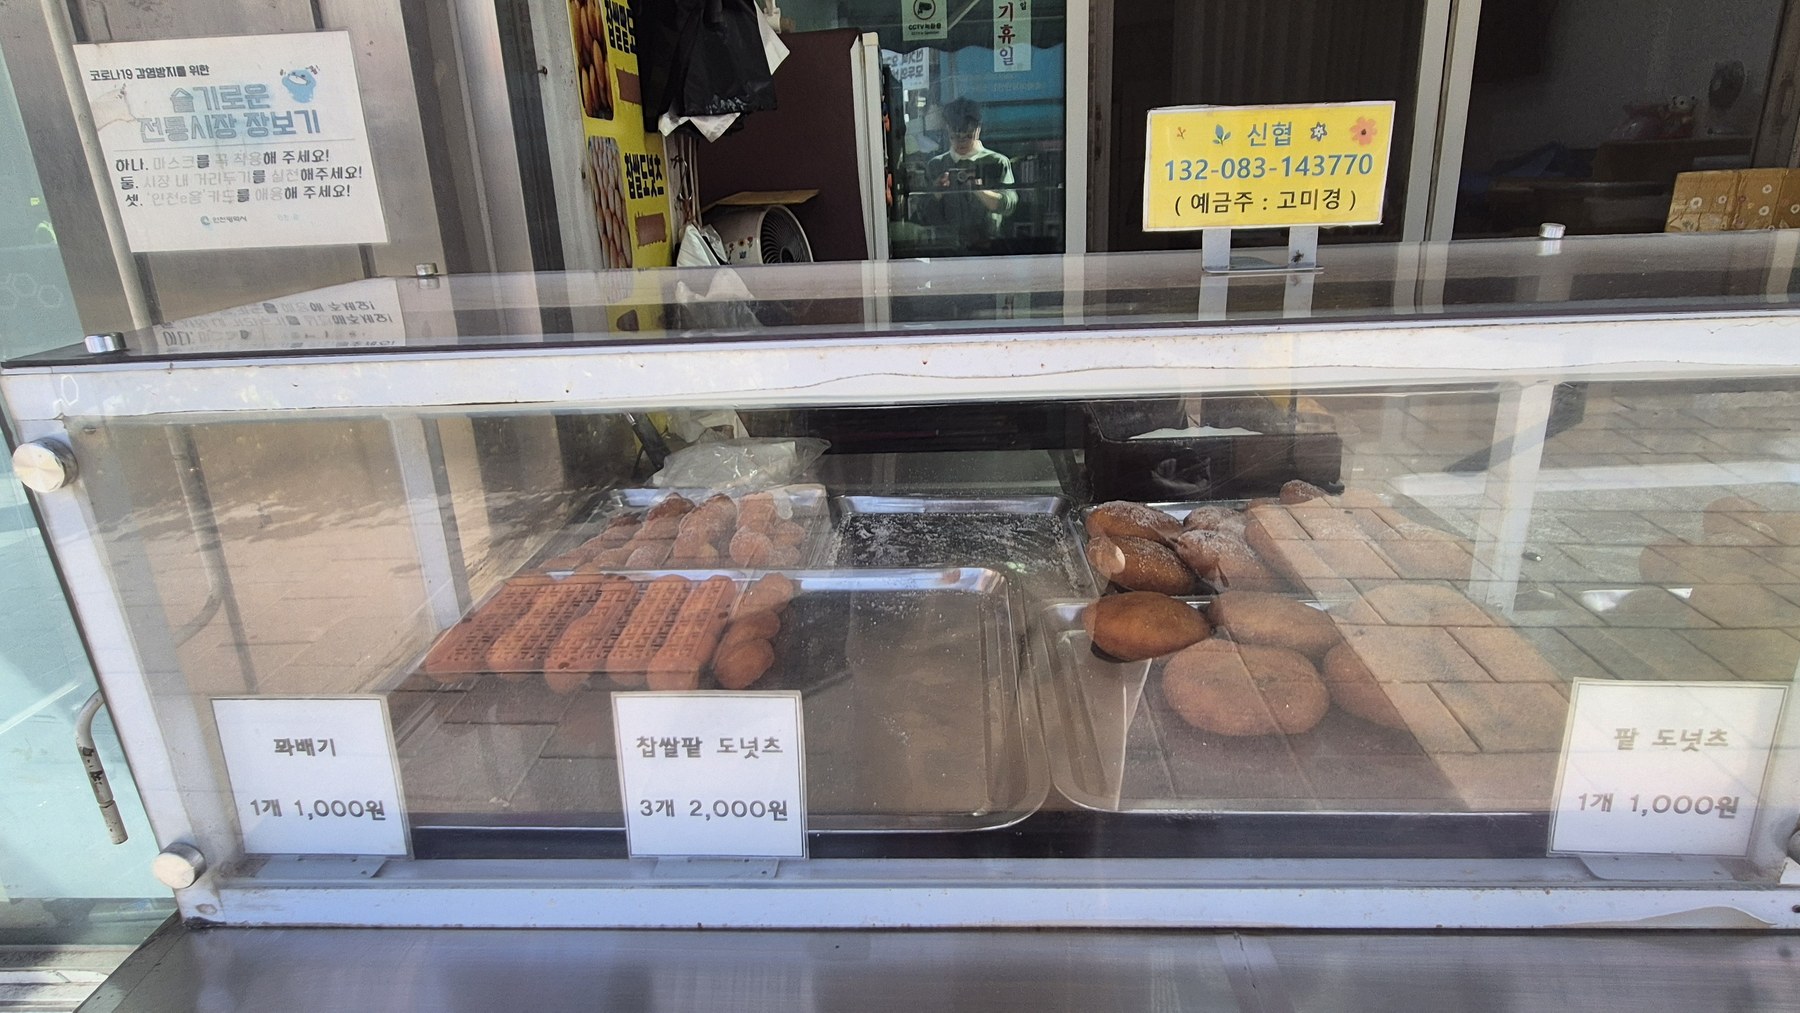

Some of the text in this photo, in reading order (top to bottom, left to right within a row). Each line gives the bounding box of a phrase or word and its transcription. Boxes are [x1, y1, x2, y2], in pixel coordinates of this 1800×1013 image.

[90, 64, 210, 81] 코로나19 감염방지를 위한
[170, 83, 271, 113] 슬기로운
[139, 109, 321, 143] 전통시장 장보기
[1247, 121, 1293, 147] 신협
[282, 149, 329, 164] 주세요!
[1164, 152, 1373, 181] 132-083-143770
[125, 193, 143, 208] 셋.
[303, 184, 350, 199] 주세요!
[273, 737, 336, 757] 꽈배기
[636, 736, 783, 759] 찹쌀팥 도넛츠
[1614, 727, 1729, 752] 팥 도넛츠
[250, 798, 386, 821] 1개 1,000원
[639, 798, 788, 821] 3개 2,000원
[1578, 792, 1740, 819] 1개 1,000원
